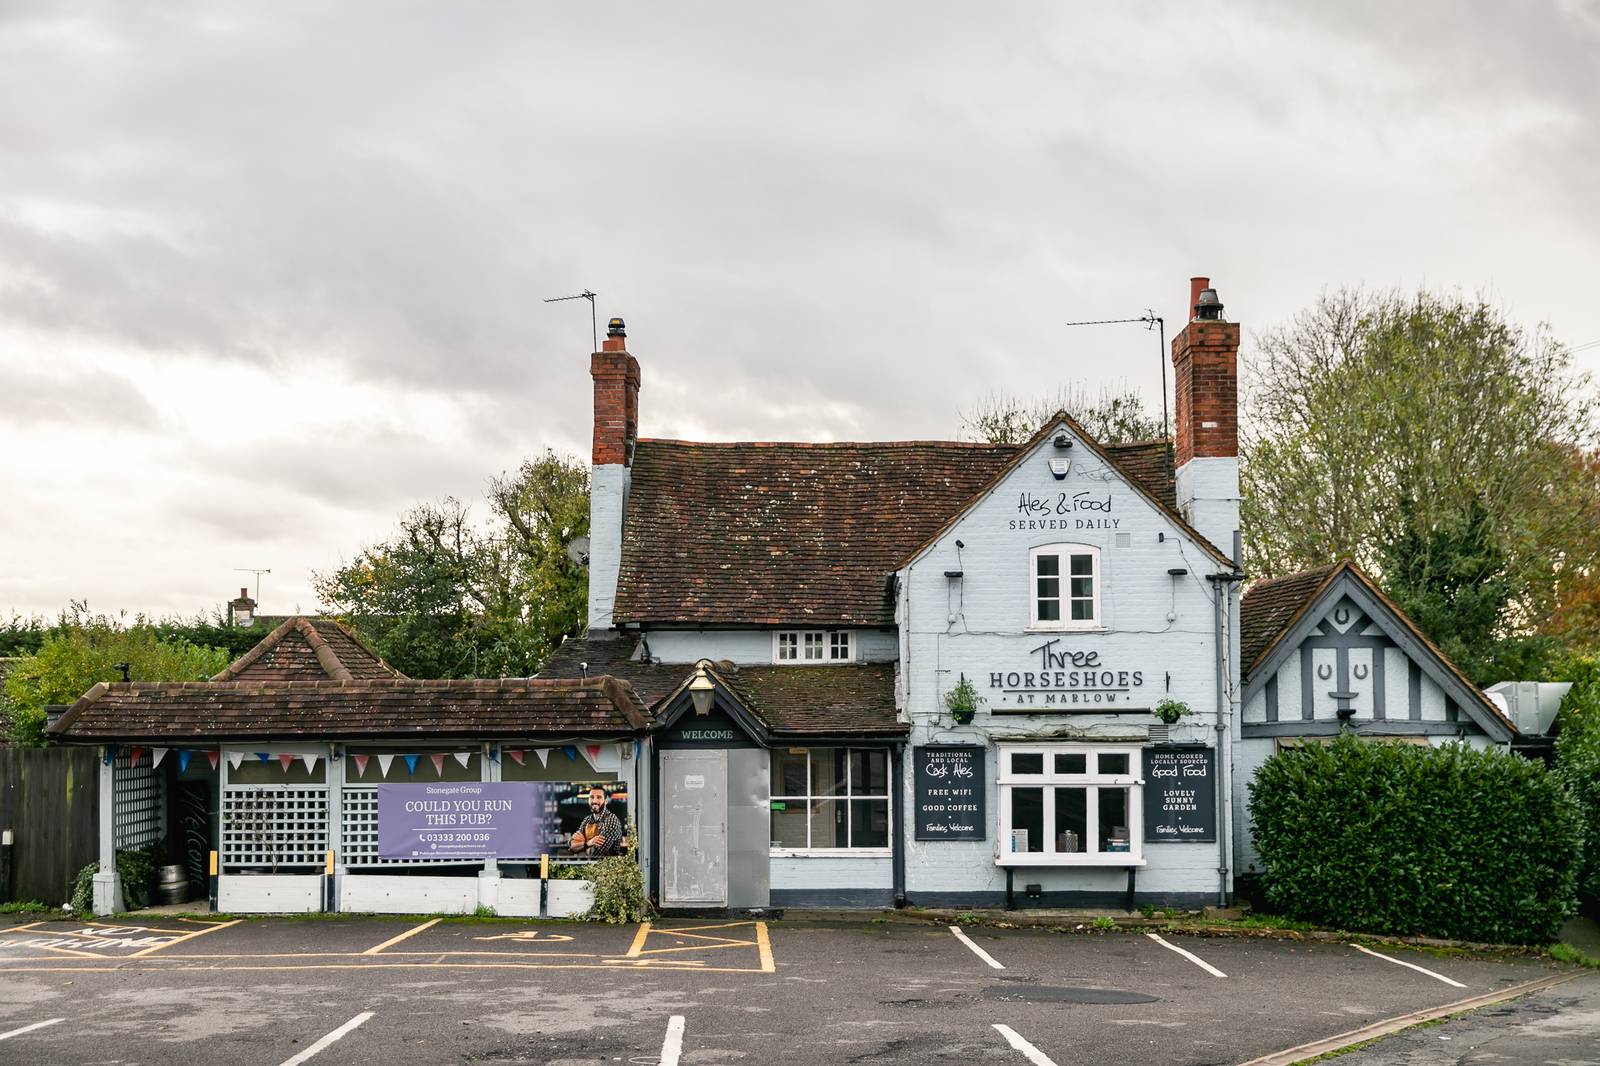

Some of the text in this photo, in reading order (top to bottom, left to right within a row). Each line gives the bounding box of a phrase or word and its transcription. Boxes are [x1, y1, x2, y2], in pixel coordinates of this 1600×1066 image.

[1018, 491, 1111, 516] Ales & Food
[1009, 519, 1120, 529] SERVED DAILY
[1030, 638, 1102, 670] Three
[990, 671, 1143, 688] HORSESHOES
[1017, 693, 1116, 703] AT MARLOW
[681, 730, 734, 739] WELCOME
[925, 763, 973, 778] Cask Ales
[1152, 764, 1207, 778] Good Food
[426, 785, 482, 795] Stonegate Group
[405, 799, 513, 812] COULD YOU RUN
[426, 814, 492, 825] THIS PUB?
[948, 823, 974, 831] Welcome
[1179, 824, 1204, 833] Welcome
[426, 833, 490, 841] 03333 200 036
